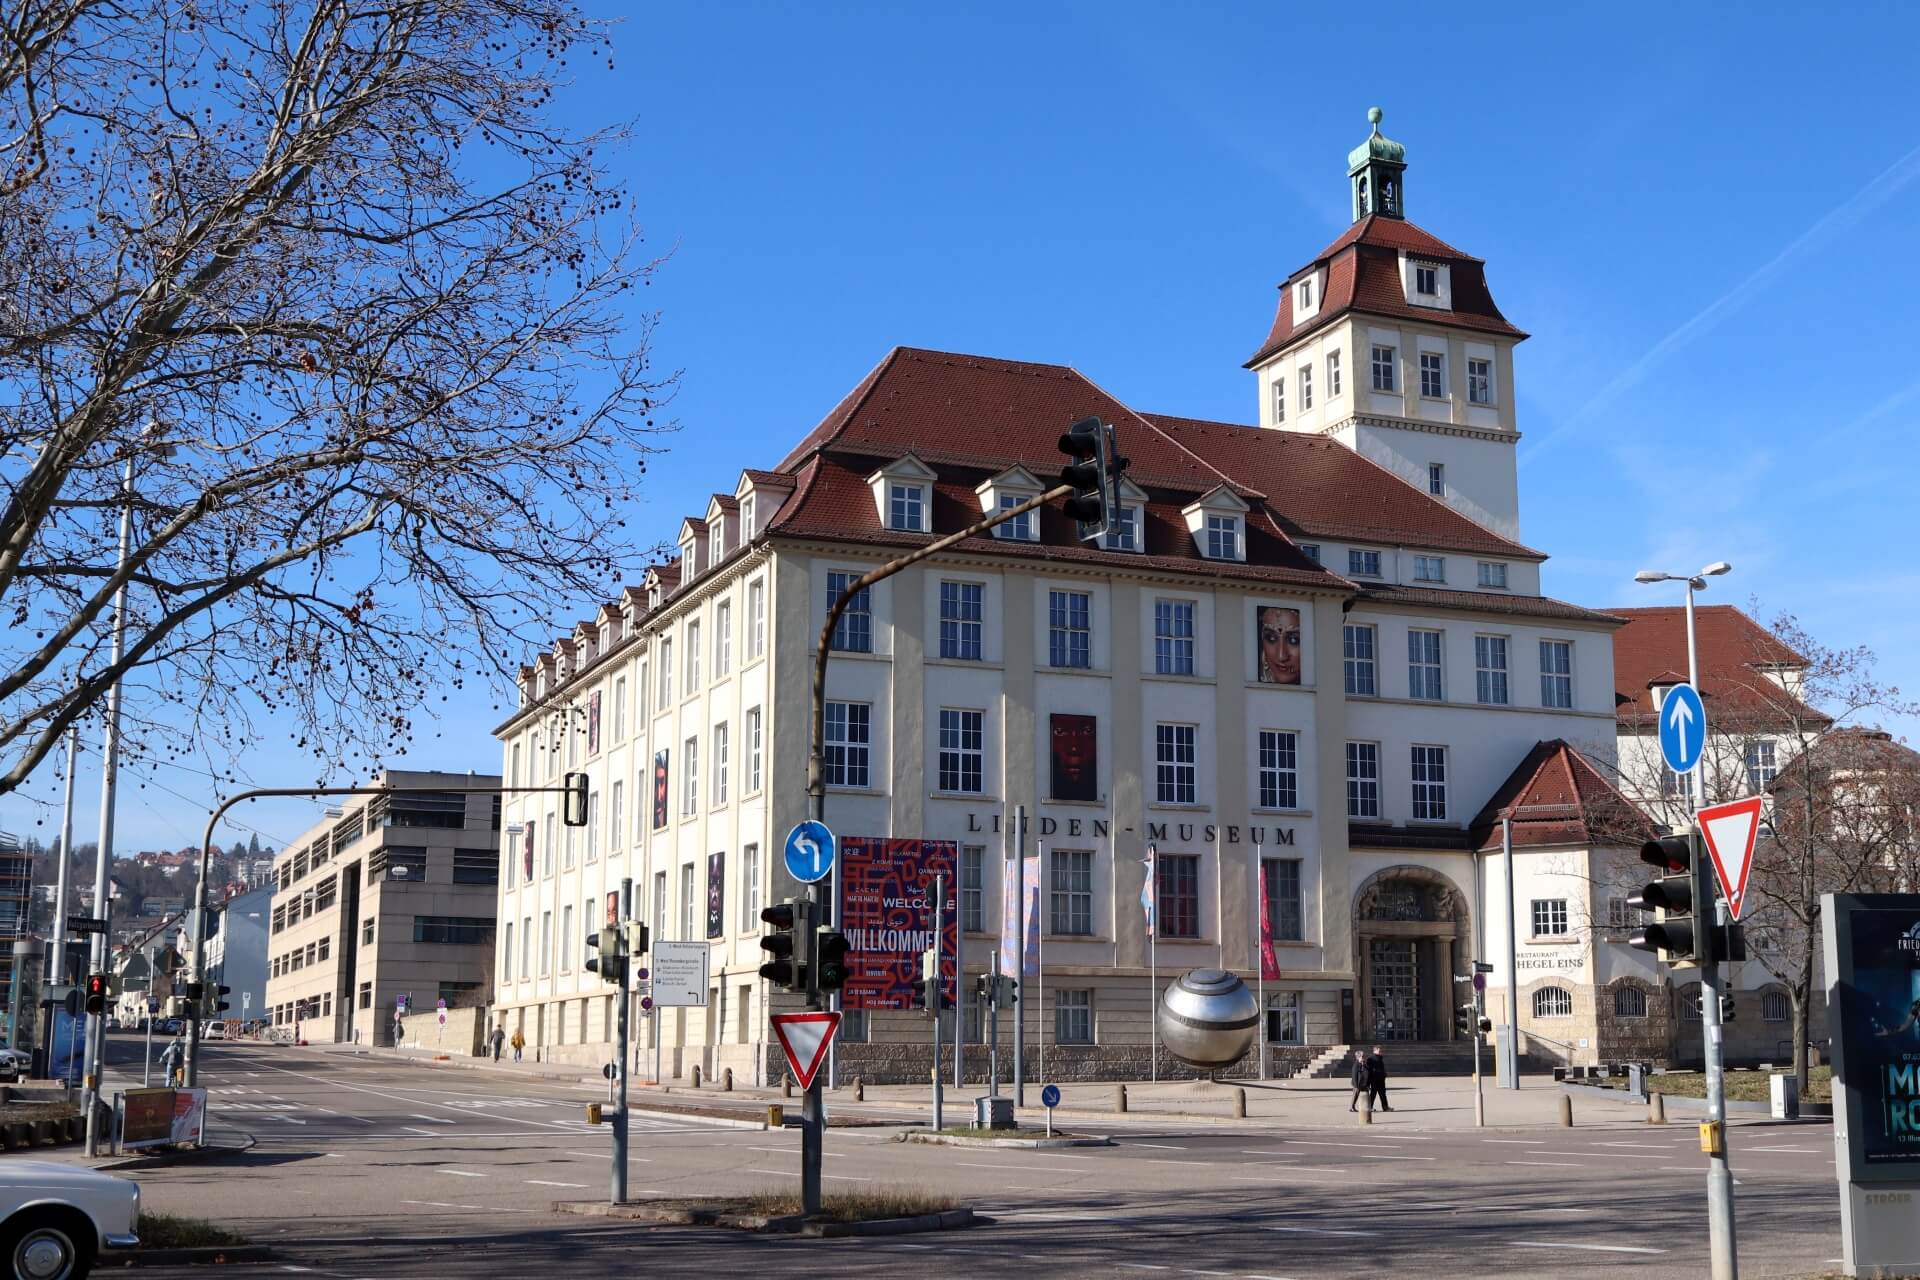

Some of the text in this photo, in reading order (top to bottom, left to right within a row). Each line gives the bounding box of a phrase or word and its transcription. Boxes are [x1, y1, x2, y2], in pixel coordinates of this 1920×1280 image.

[882, 897, 955, 910] WELCOE
[843, 929, 943, 953] WILLKOMMEN
[1516, 951, 1559, 959] RESTAURANT
[1516, 959, 1584, 969] HEGEL EINS
[1888, 1063, 1920, 1096] M
